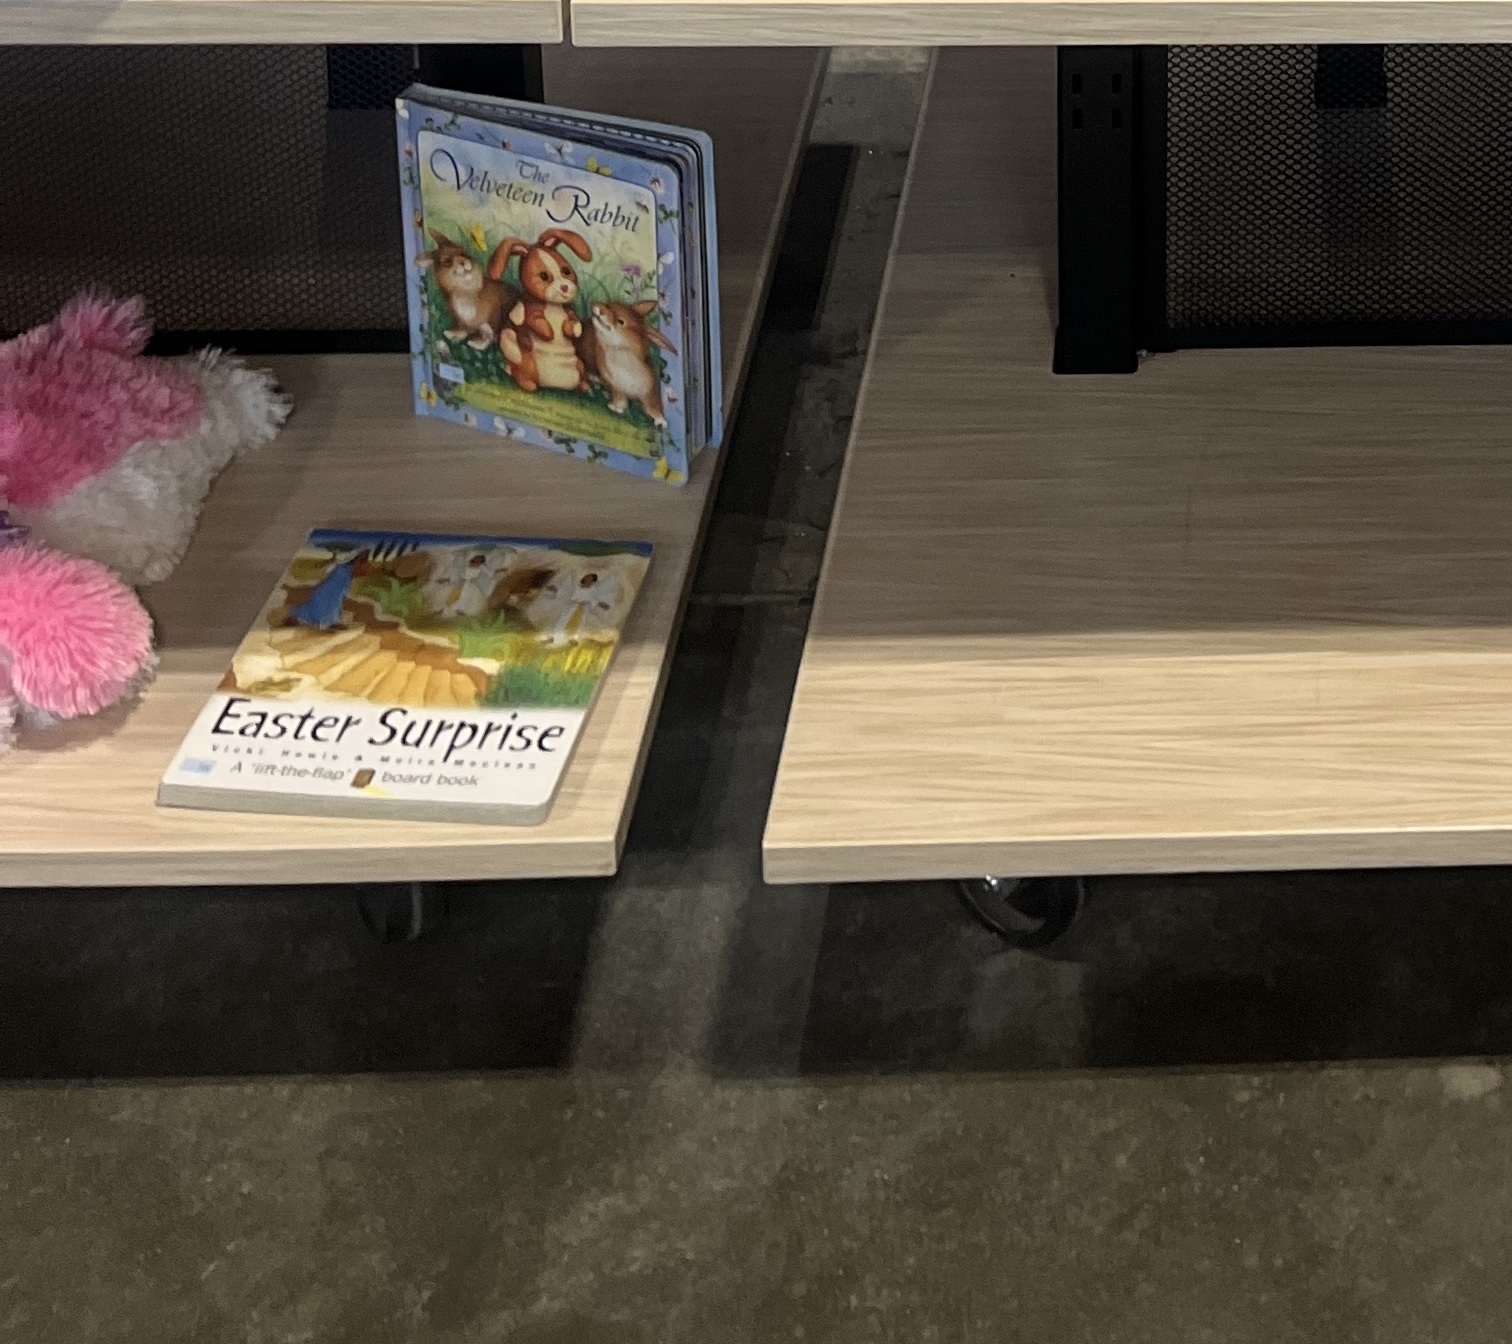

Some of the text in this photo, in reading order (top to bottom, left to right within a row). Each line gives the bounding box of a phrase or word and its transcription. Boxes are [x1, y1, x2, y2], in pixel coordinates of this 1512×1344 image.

[430, 148, 640, 232] Velveteen Rabbit
[515, 159, 550, 185] The
[211, 696, 567, 764] Easter Surprise
[381, 771, 432, 786] board
[436, 773, 479, 786] book
